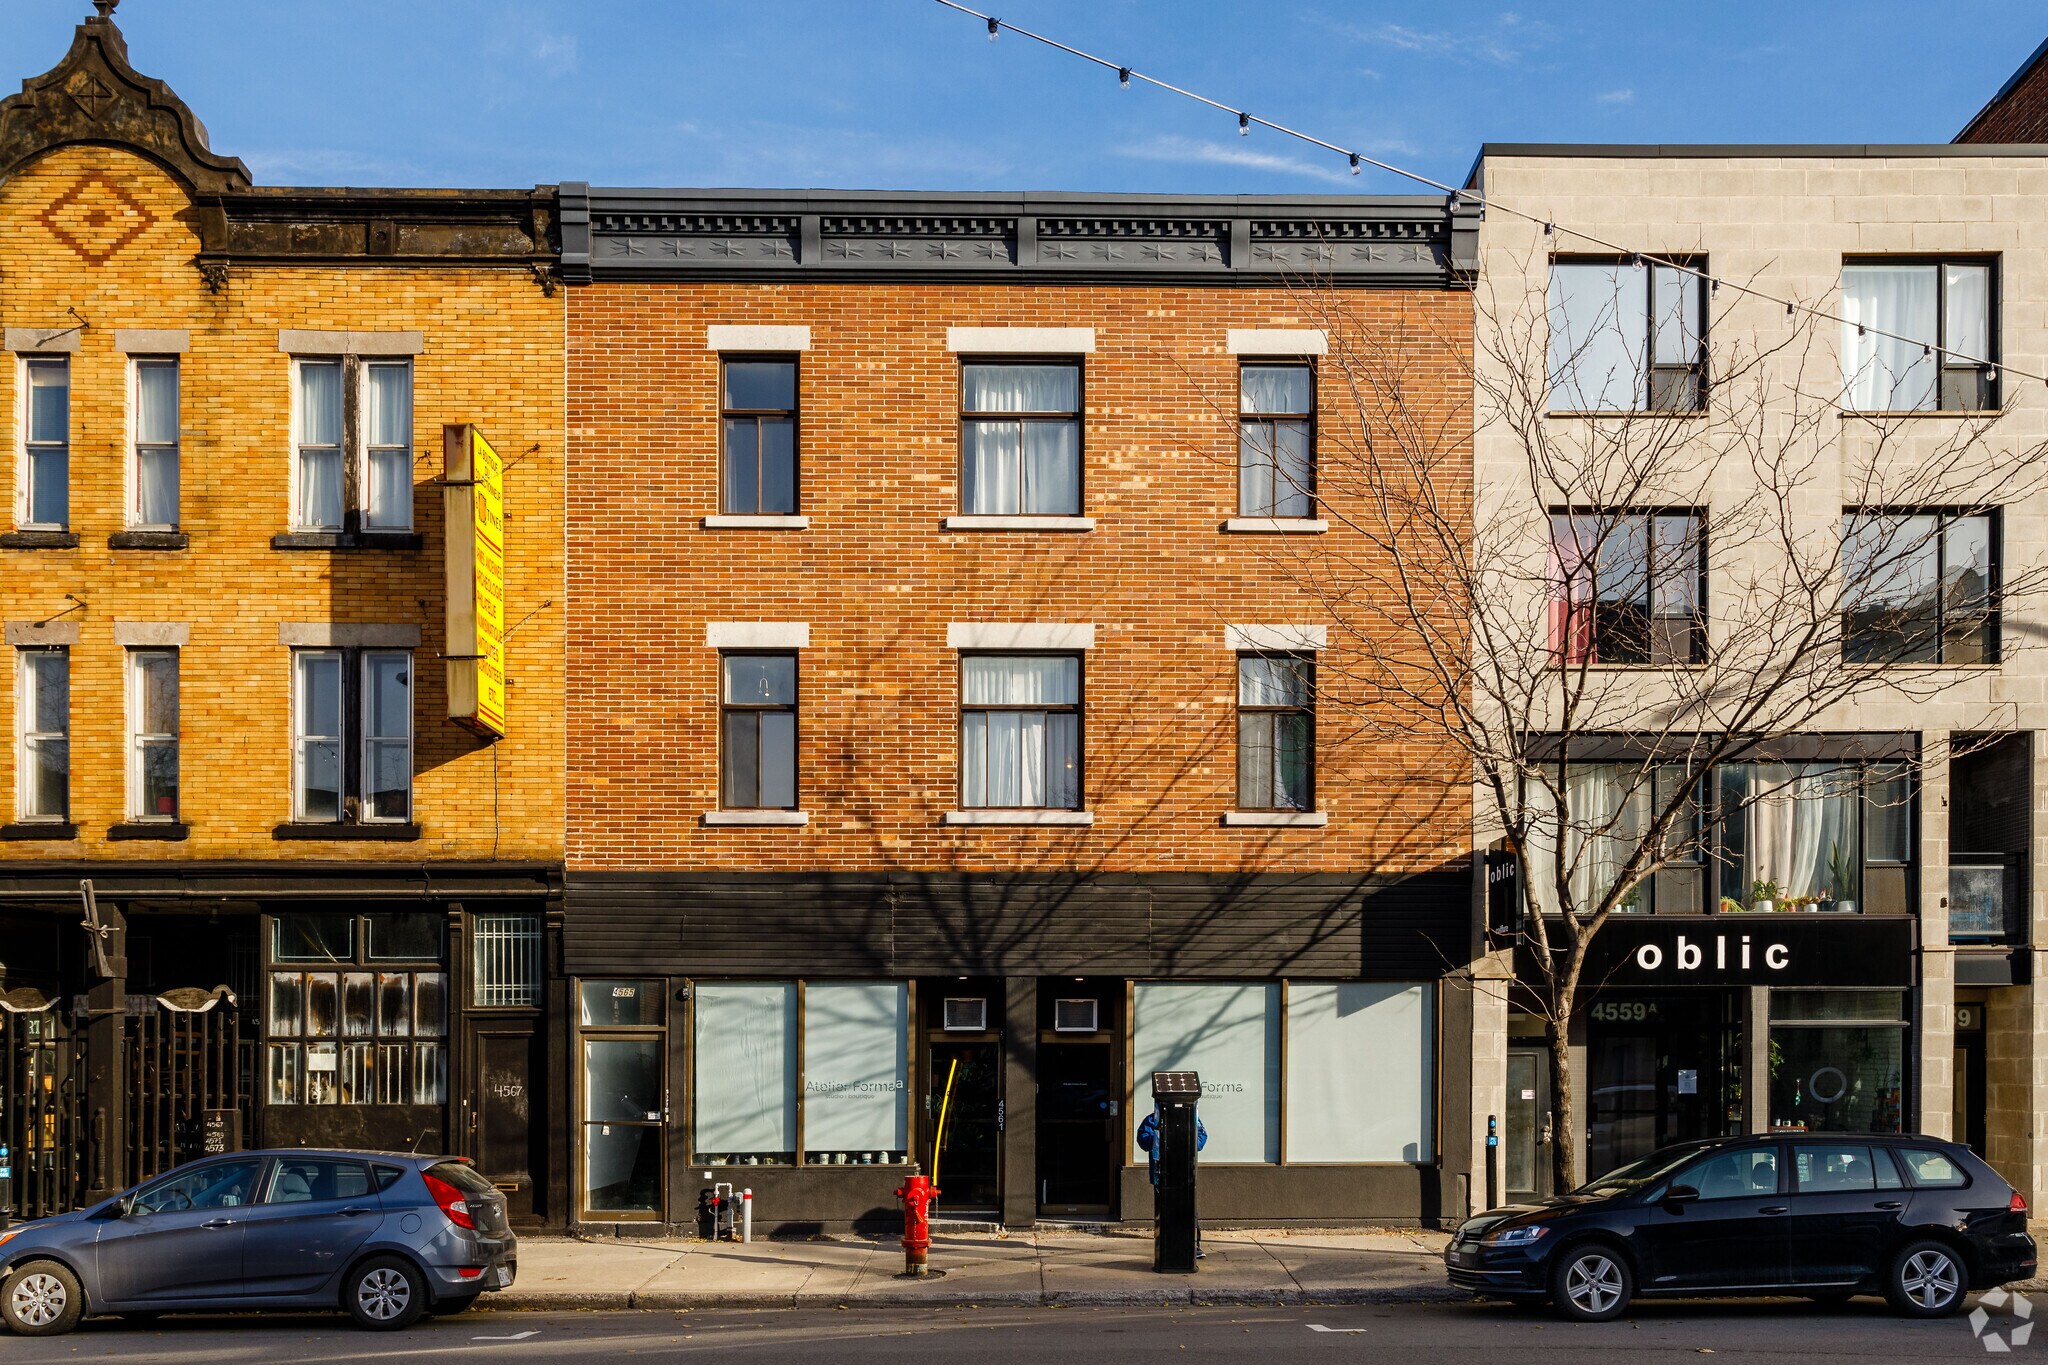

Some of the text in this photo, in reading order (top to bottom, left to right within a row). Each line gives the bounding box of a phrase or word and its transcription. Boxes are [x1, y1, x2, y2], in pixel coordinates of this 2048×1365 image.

[1490, 862, 1515, 884] oblic
[1636, 935, 1789, 970] oblic
[612, 986, 636, 998] 4565
[494, 1083, 523, 1098] 4567
[805, 1080, 848, 1092] Atelier
[1200, 1081, 1244, 1093] Forma
[848, 1093, 876, 1101] boutique
[204, 1143, 225, 1152] 4573
